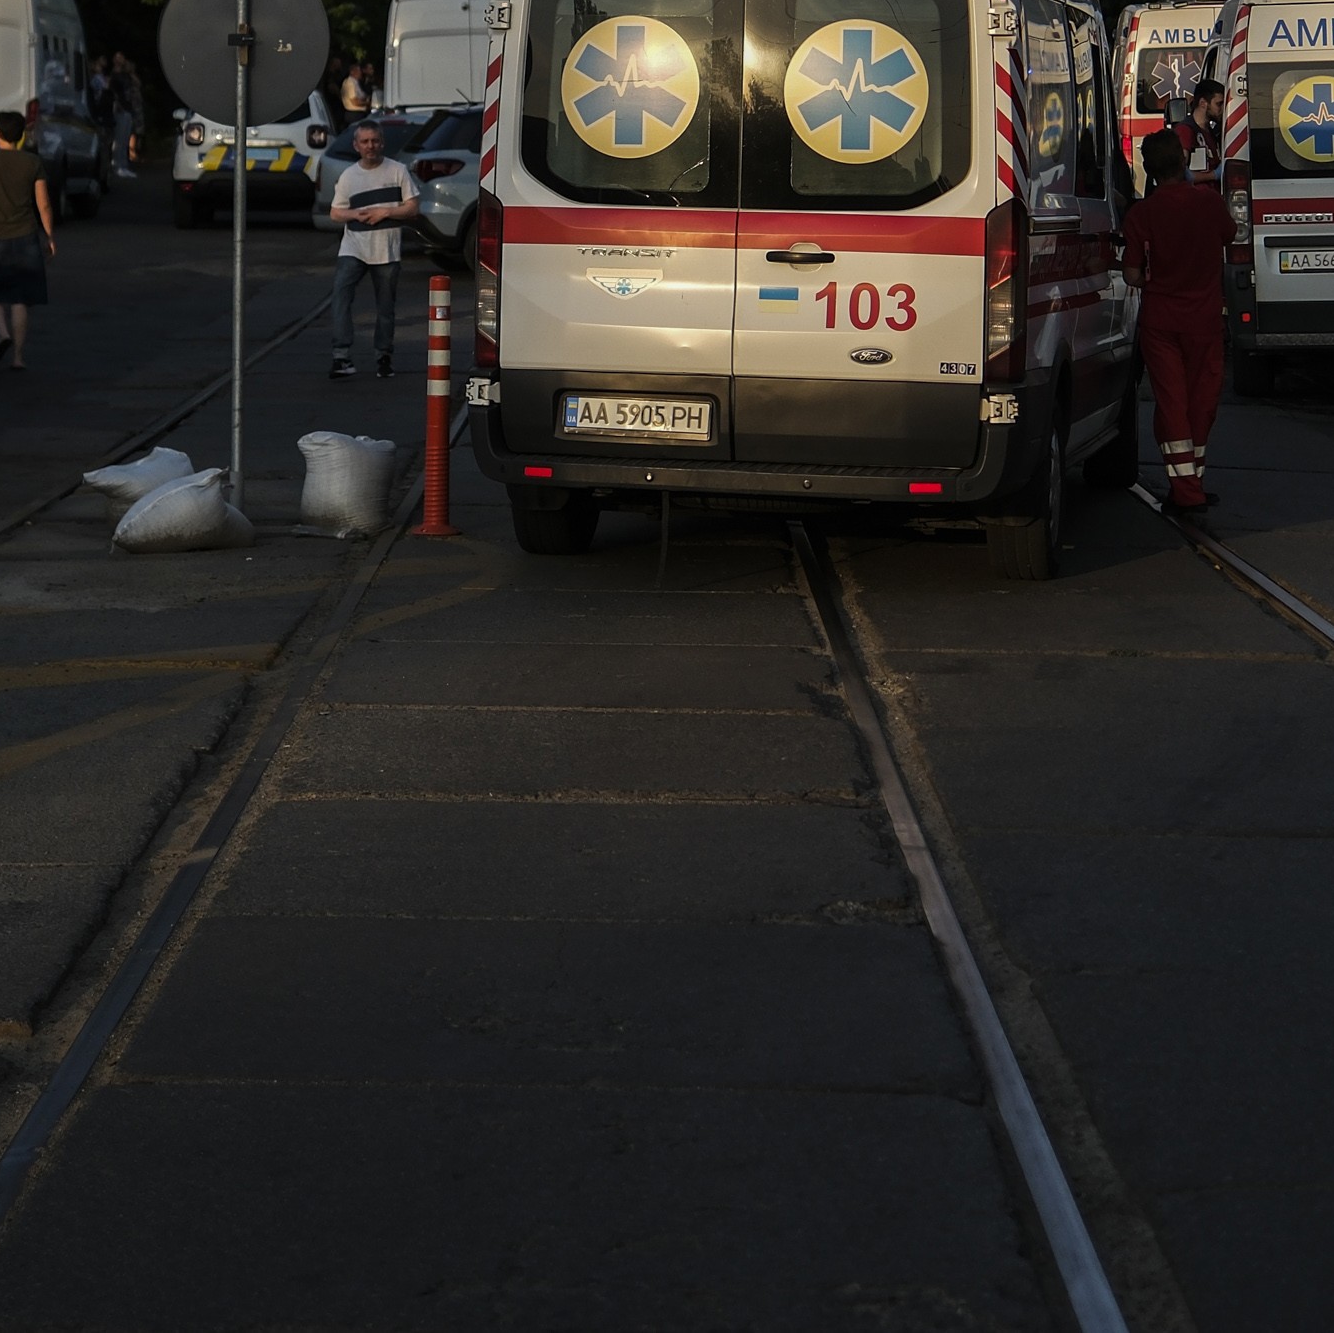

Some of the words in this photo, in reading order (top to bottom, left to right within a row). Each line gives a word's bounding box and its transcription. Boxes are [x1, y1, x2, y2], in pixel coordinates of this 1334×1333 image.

[1263, 213, 1333, 223] PEUGEOT
[576, 247, 678, 258] TRANSIT
[1291, 254, 1310, 267] AA
[815, 281, 917, 332] 103
[940, 363, 976, 375] 4307
[579, 401, 609, 425] AA
[616, 403, 665, 427] 5905
[671, 406, 703, 429] PH
